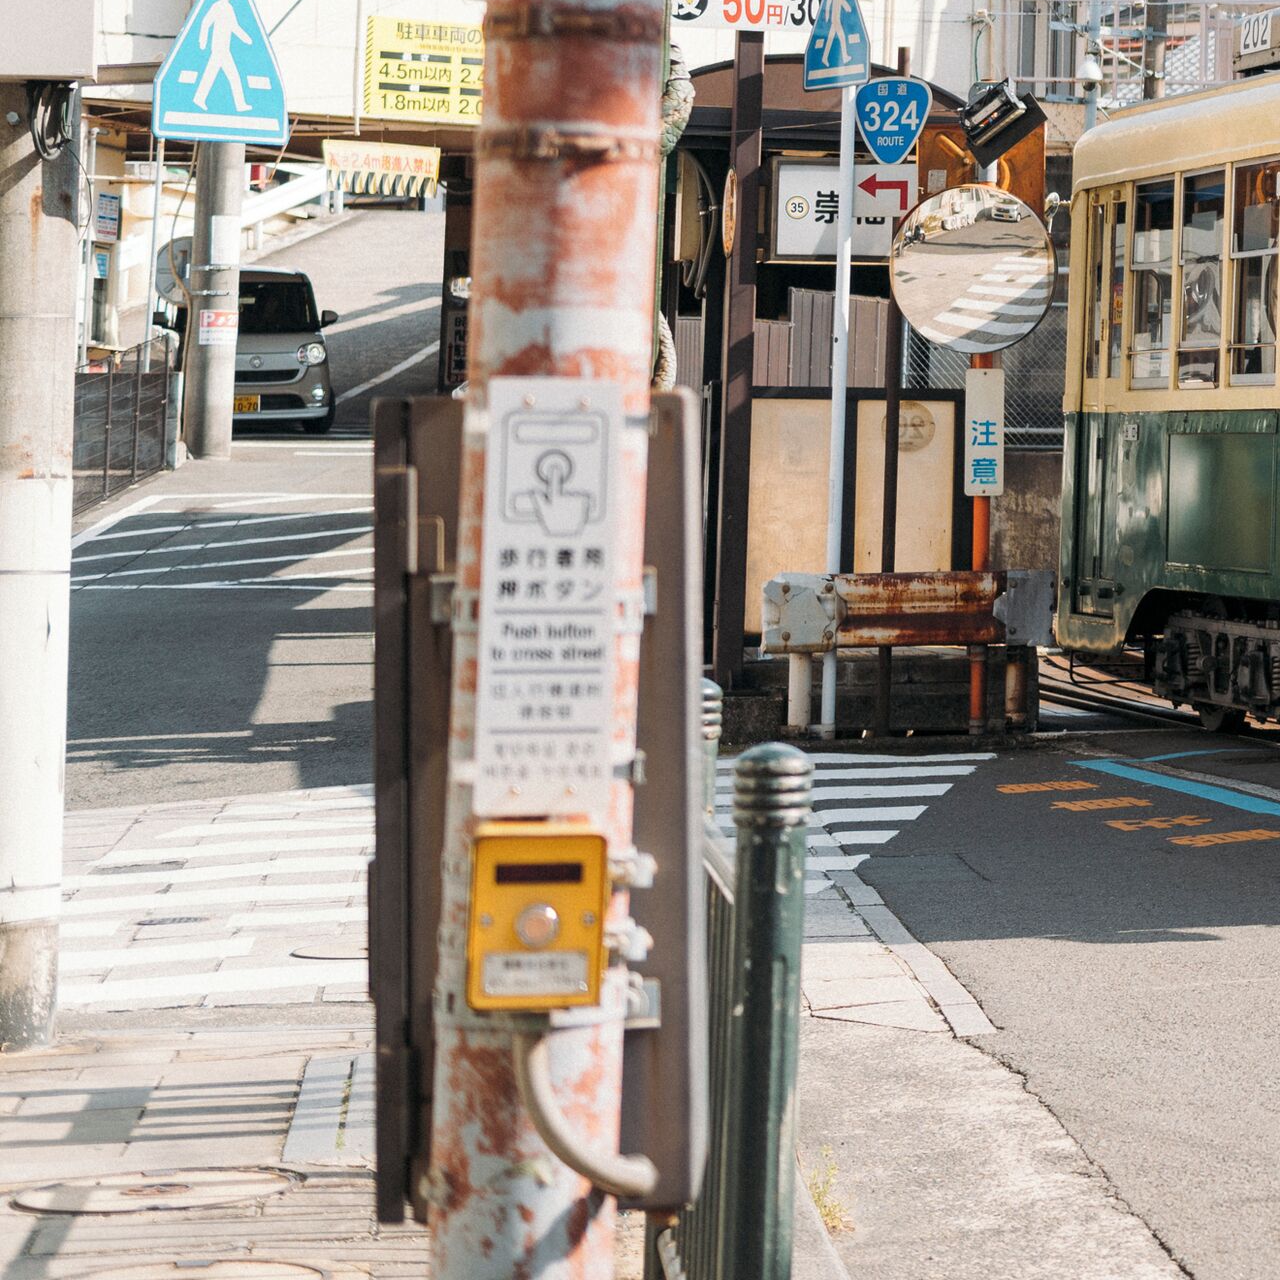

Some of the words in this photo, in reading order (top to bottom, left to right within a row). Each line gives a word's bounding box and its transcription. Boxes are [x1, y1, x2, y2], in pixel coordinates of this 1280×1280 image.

[1243, 15, 1270, 49] 202
[379, 63, 452, 82] 4.5m以内
[878, 83, 907, 96] 国道
[380, 94, 450, 113] 1.8m以内
[864, 100, 920, 132] 324
[876, 136, 905, 147] ROUTE
[790, 202, 804, 213] 35
[971, 420, 998, 484] 注意
[503, 624, 538, 640] Push
[546, 624, 594, 641] button
[512, 648, 553, 661] cross
[561, 646, 604, 661] street
